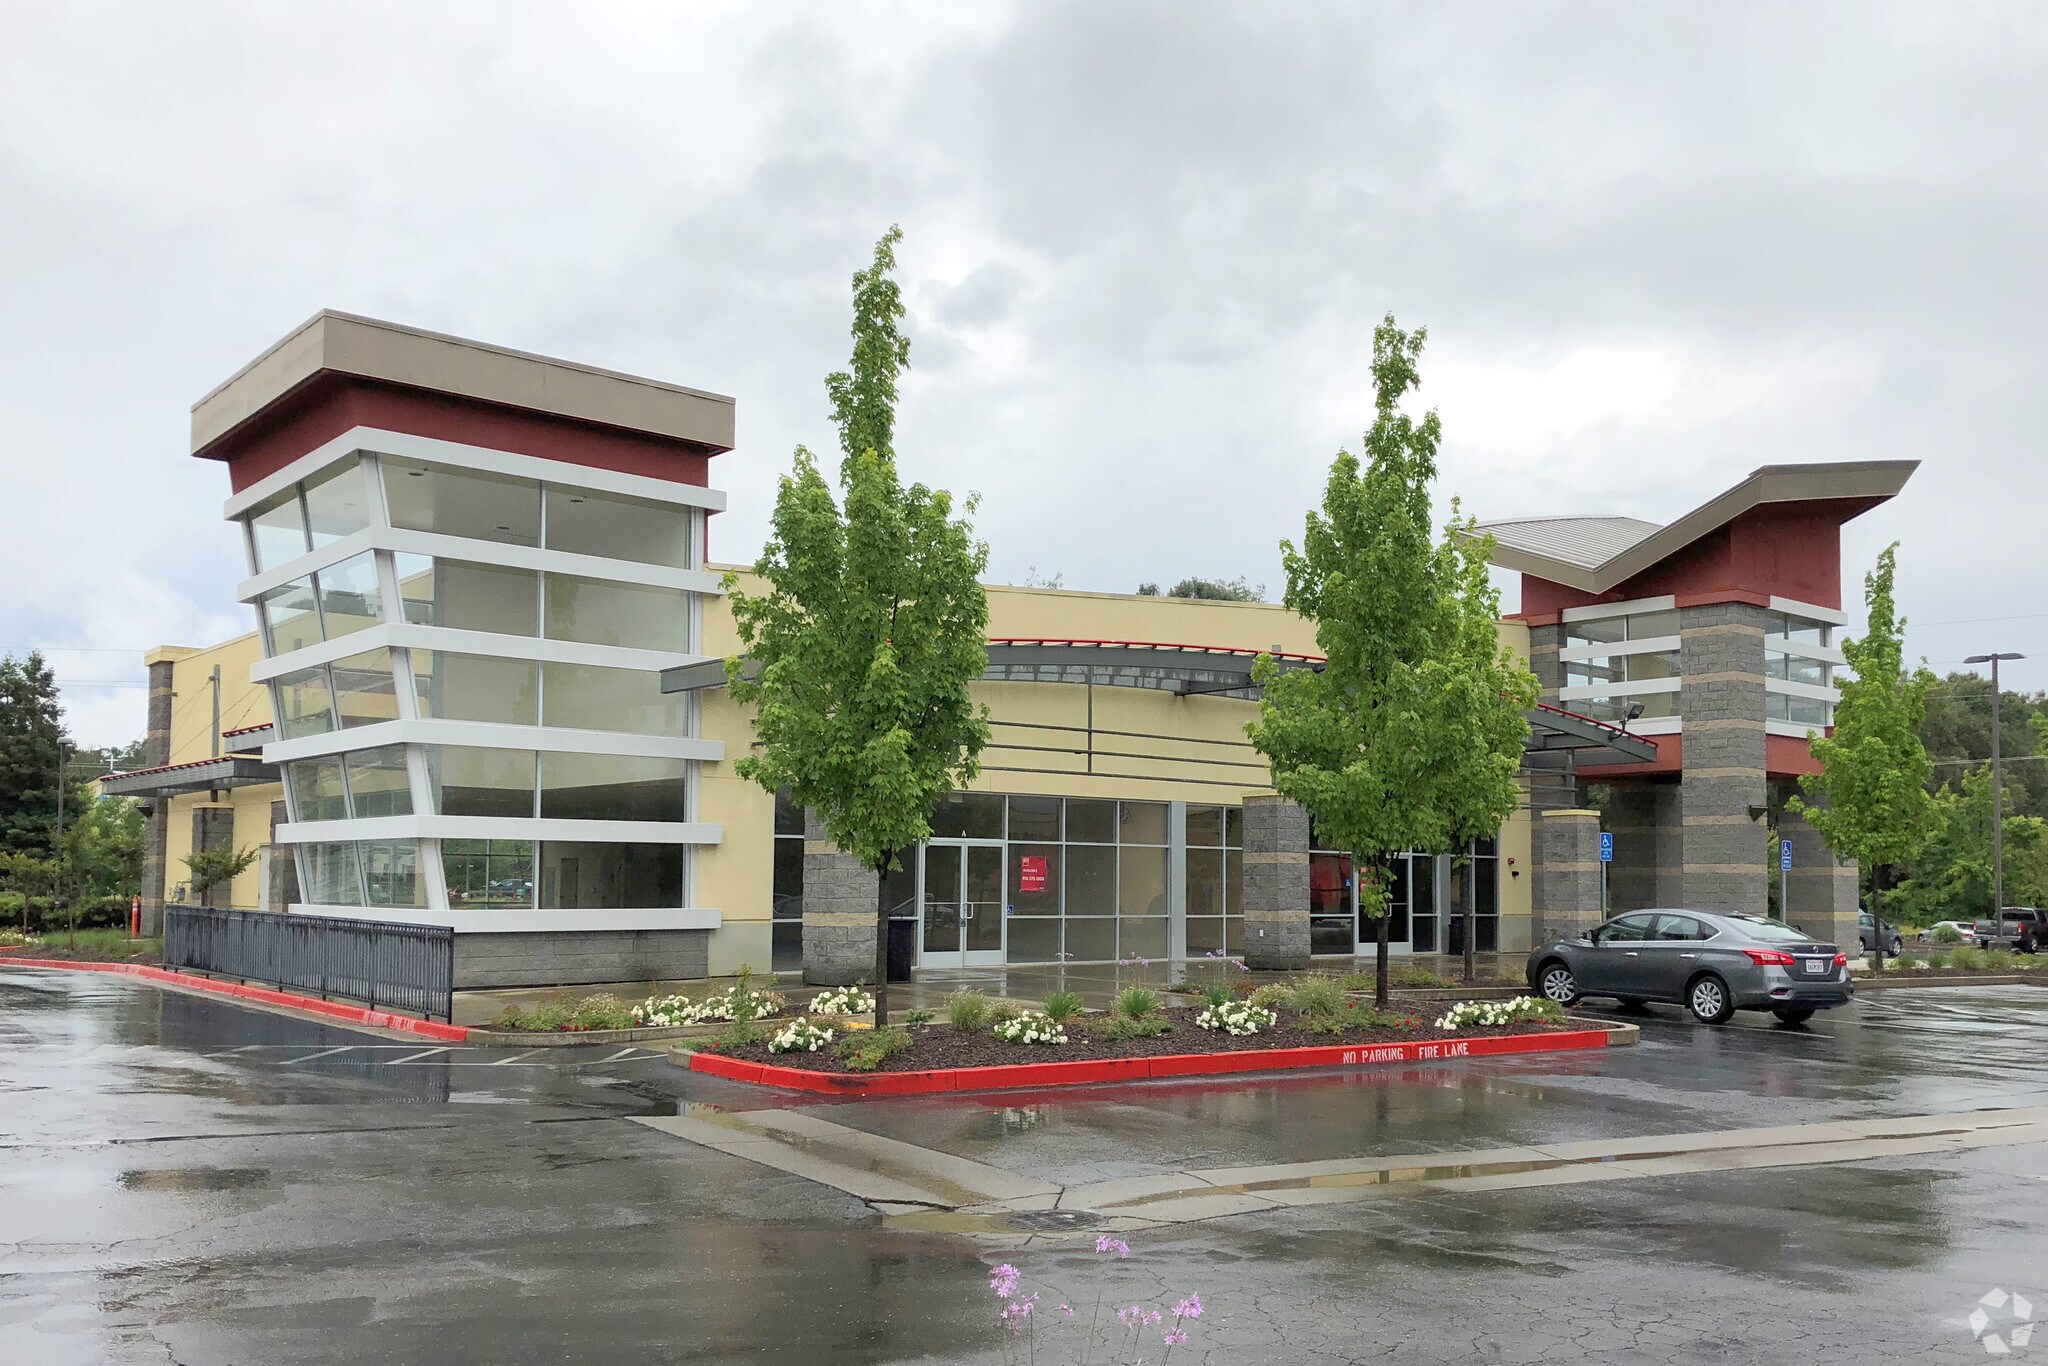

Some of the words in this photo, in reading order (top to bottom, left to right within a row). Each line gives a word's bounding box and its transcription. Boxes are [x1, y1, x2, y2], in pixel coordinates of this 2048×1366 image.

[1343, 1051, 1356, 1064] NO
[1362, 1047, 1404, 1063] PARKING
[1419, 1045, 1439, 1060] FIRE
[1444, 1042, 1469, 1057] LANE
